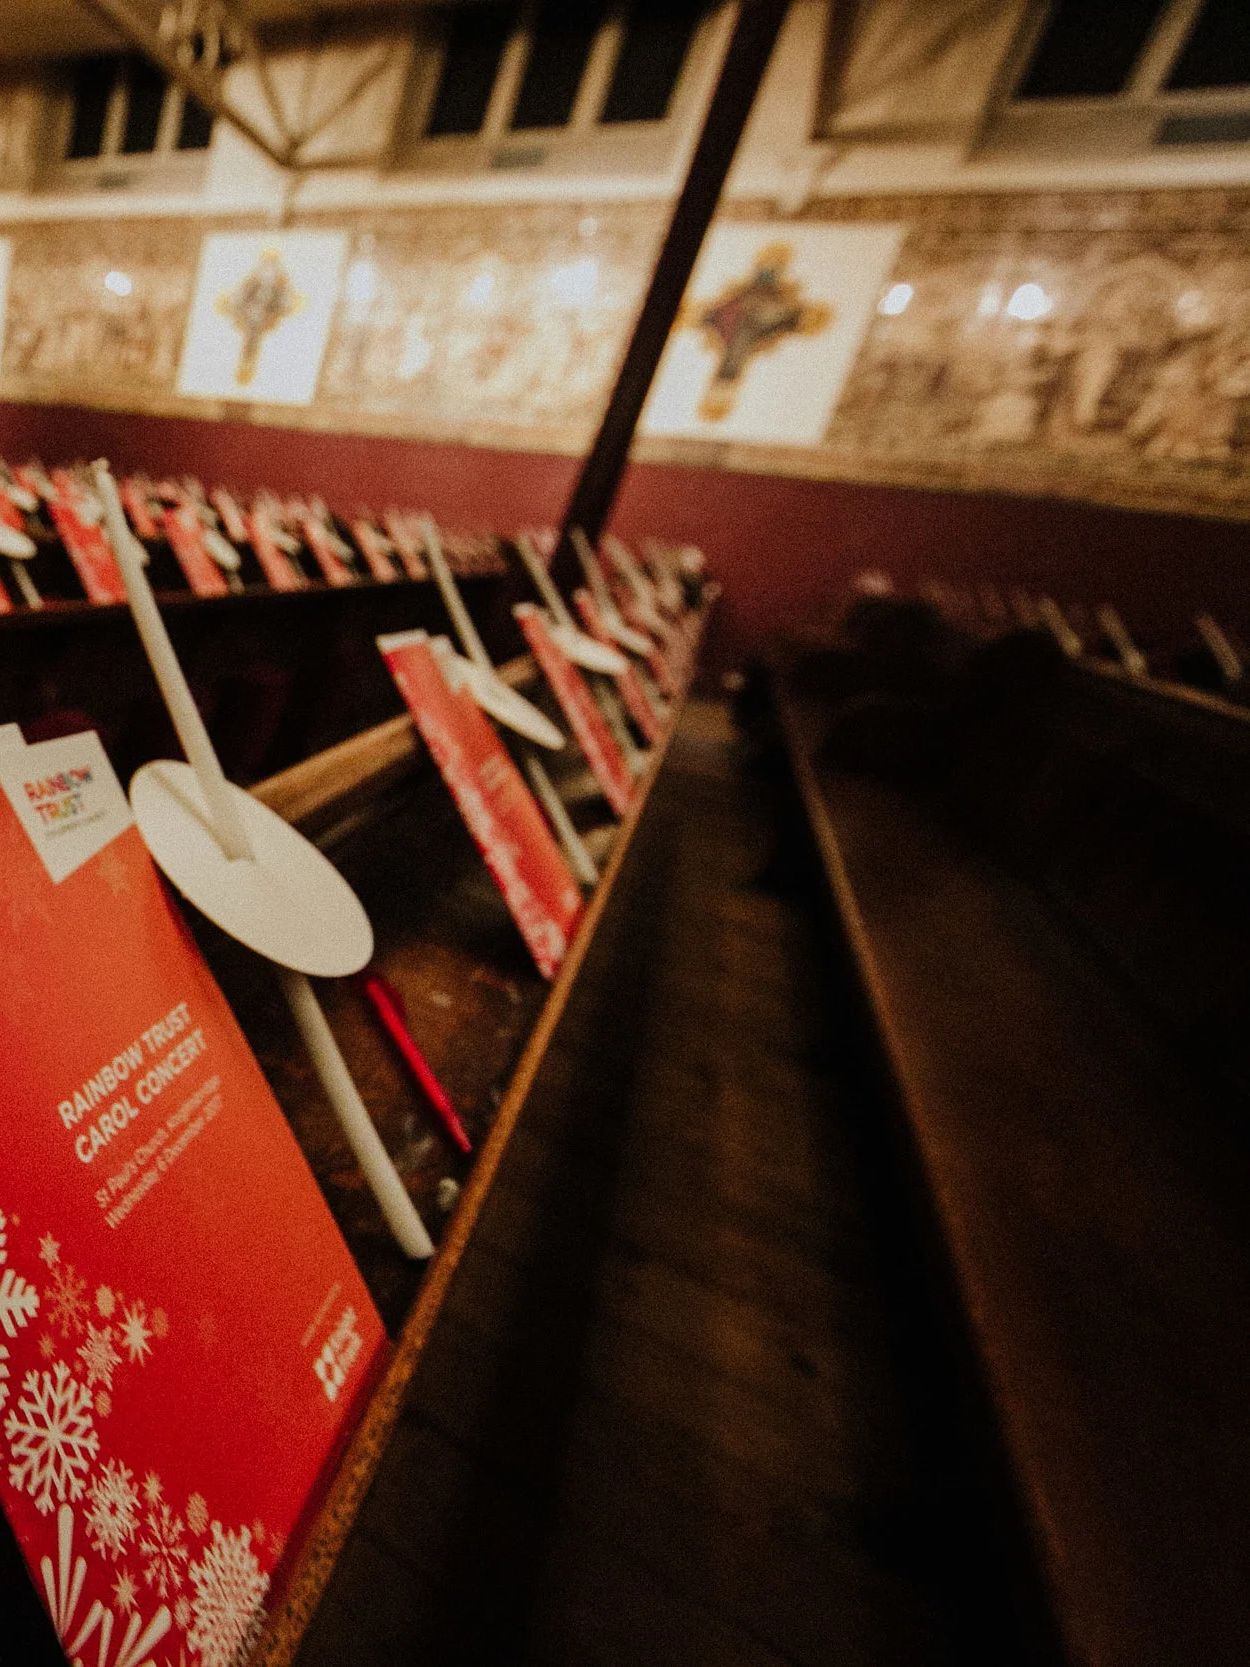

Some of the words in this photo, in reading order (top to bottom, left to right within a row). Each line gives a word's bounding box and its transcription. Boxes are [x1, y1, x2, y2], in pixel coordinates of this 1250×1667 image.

[57, 1040, 145, 1129] RAINBOW
[141, 1001, 191, 1054] TRUST
[74, 1096, 139, 1163] CAROL
[135, 1027, 206, 1104] CONCERT
